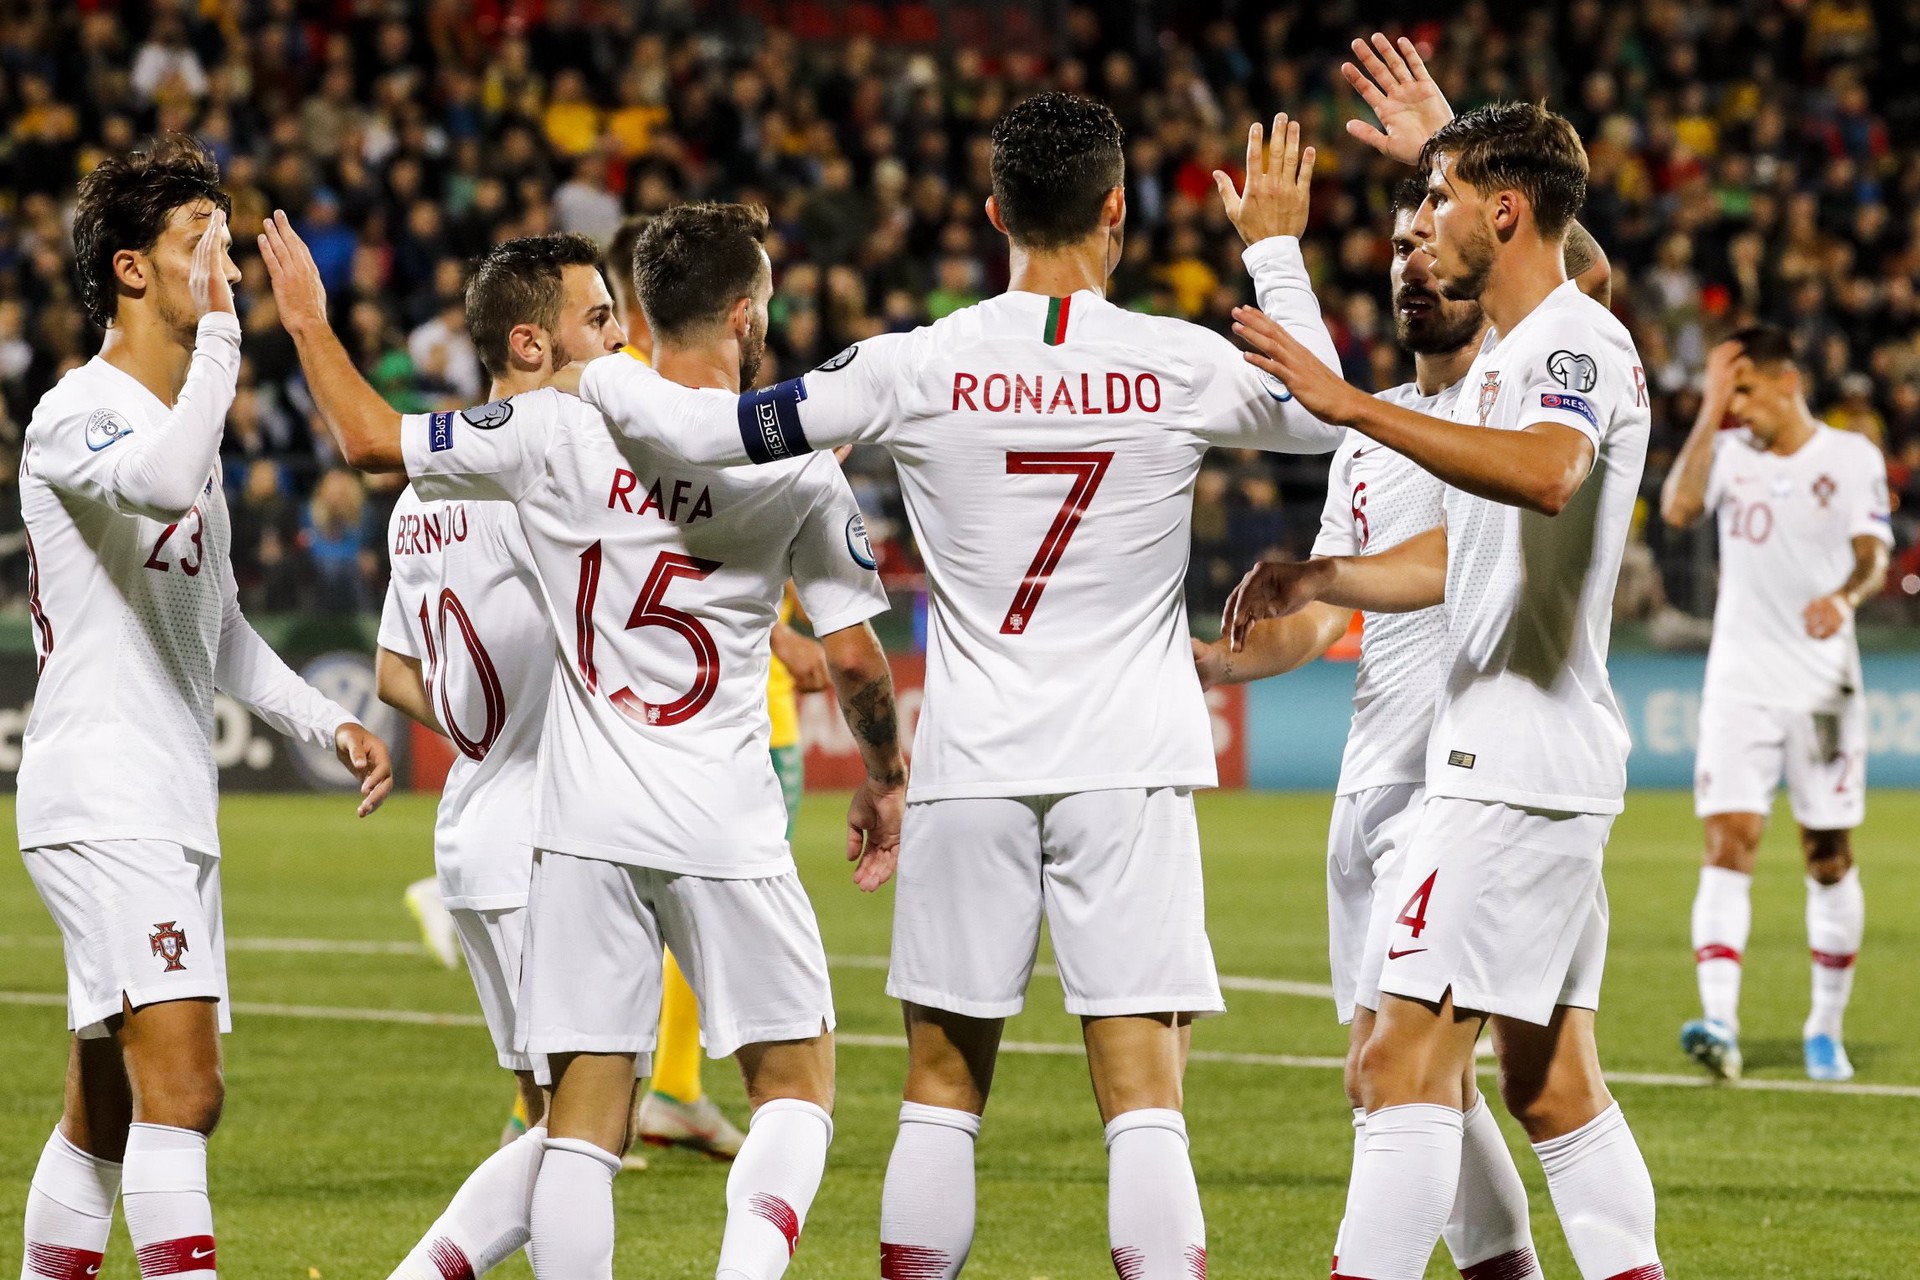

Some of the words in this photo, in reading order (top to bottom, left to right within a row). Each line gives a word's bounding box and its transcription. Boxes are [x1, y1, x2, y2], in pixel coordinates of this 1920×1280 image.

[952, 372, 1162, 415] RONALDO
[435, 413, 447, 449] ESPECT
[760, 403, 786, 455] RESPECT
[607, 467, 714, 525] RAFA
[143, 504, 204, 578] 23
[394, 502, 469, 556] BERNDO
[999, 451, 1116, 635] 7
[575, 538, 725, 727] 15
[417, 586, 506, 763] 10
[1395, 866, 1440, 939] 4
